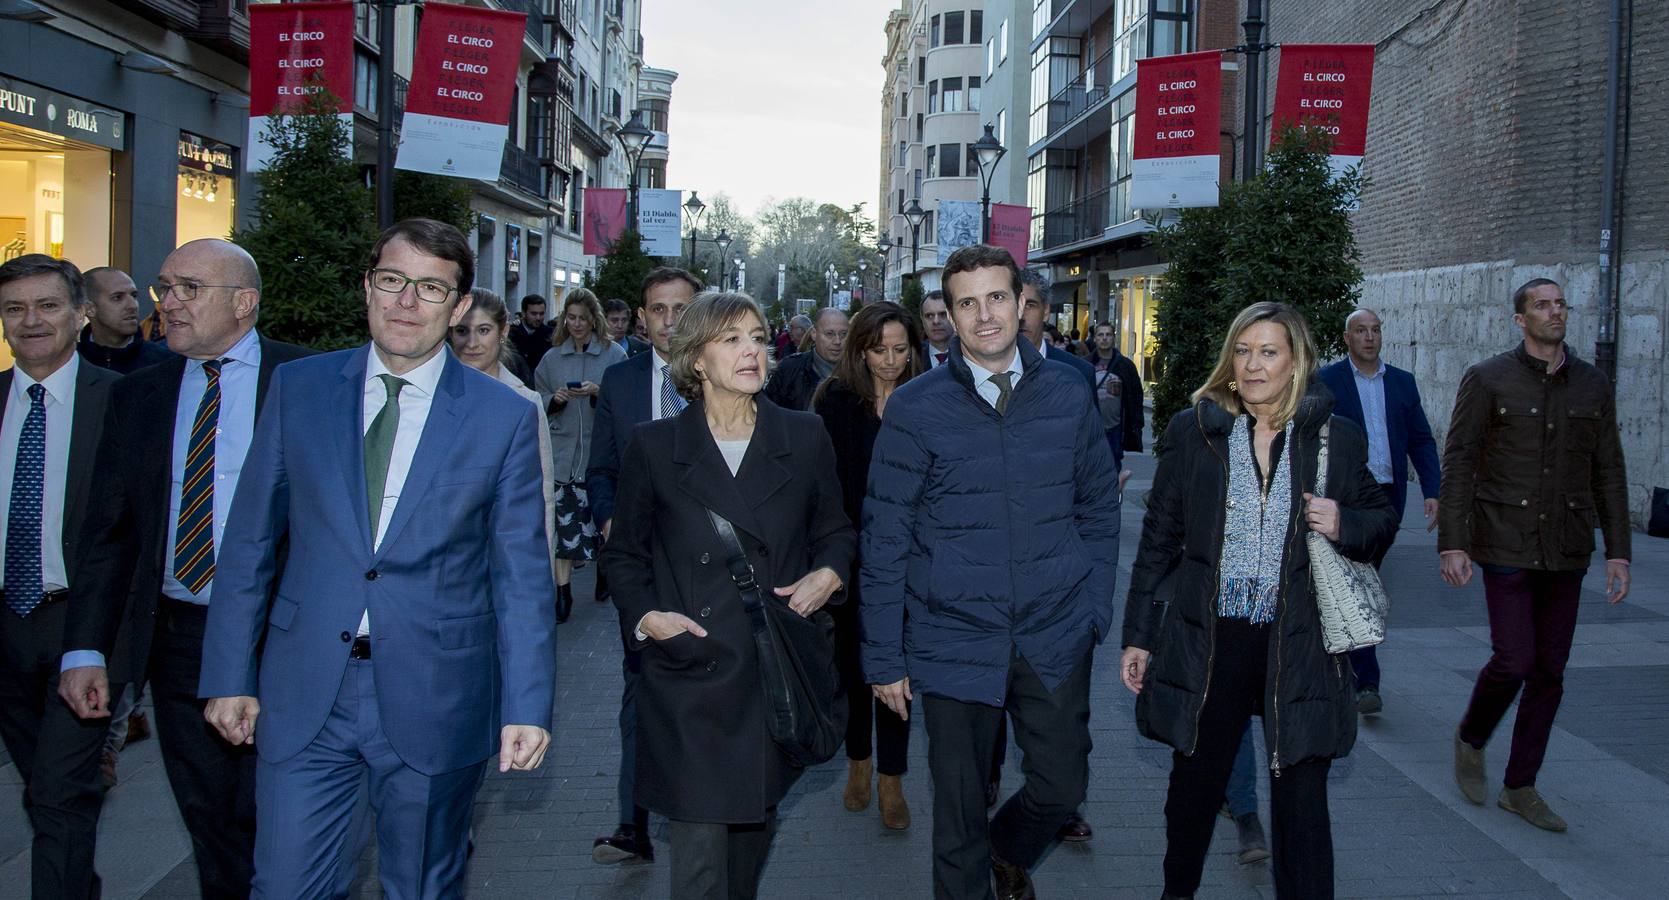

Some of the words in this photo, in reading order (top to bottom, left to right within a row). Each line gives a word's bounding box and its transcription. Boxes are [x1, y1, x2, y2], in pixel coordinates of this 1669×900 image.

[279, 33, 291, 42] EL
[293, 31, 325, 41] CIRCO
[447, 34, 459, 44] EL
[461, 36, 494, 48] CIRCO
[278, 59, 290, 68] EL
[293, 58, 324, 68] CIRCO
[442, 60, 454, 70] EL
[456, 62, 488, 75] CIRCO
[1303, 73, 1314, 81] EL
[1316, 73, 1345, 82] CIRCO
[277, 86, 291, 95] EL
[1159, 83, 1168, 92] EL
[1170, 80, 1197, 90] CIRCO
[437, 87, 449, 97] EL
[451, 89, 484, 101] CIRCO
[1300, 99, 1311, 107] EL
[1313, 99, 1343, 109] CIRCO
[0, 88, 36, 116] PUNT
[67, 108, 98, 133] ROMA
[1157, 107, 1168, 116] EL
[1169, 105, 1196, 115] CIRCO
[1156, 131, 1166, 140] EL
[1168, 129, 1195, 139] CIRCO
